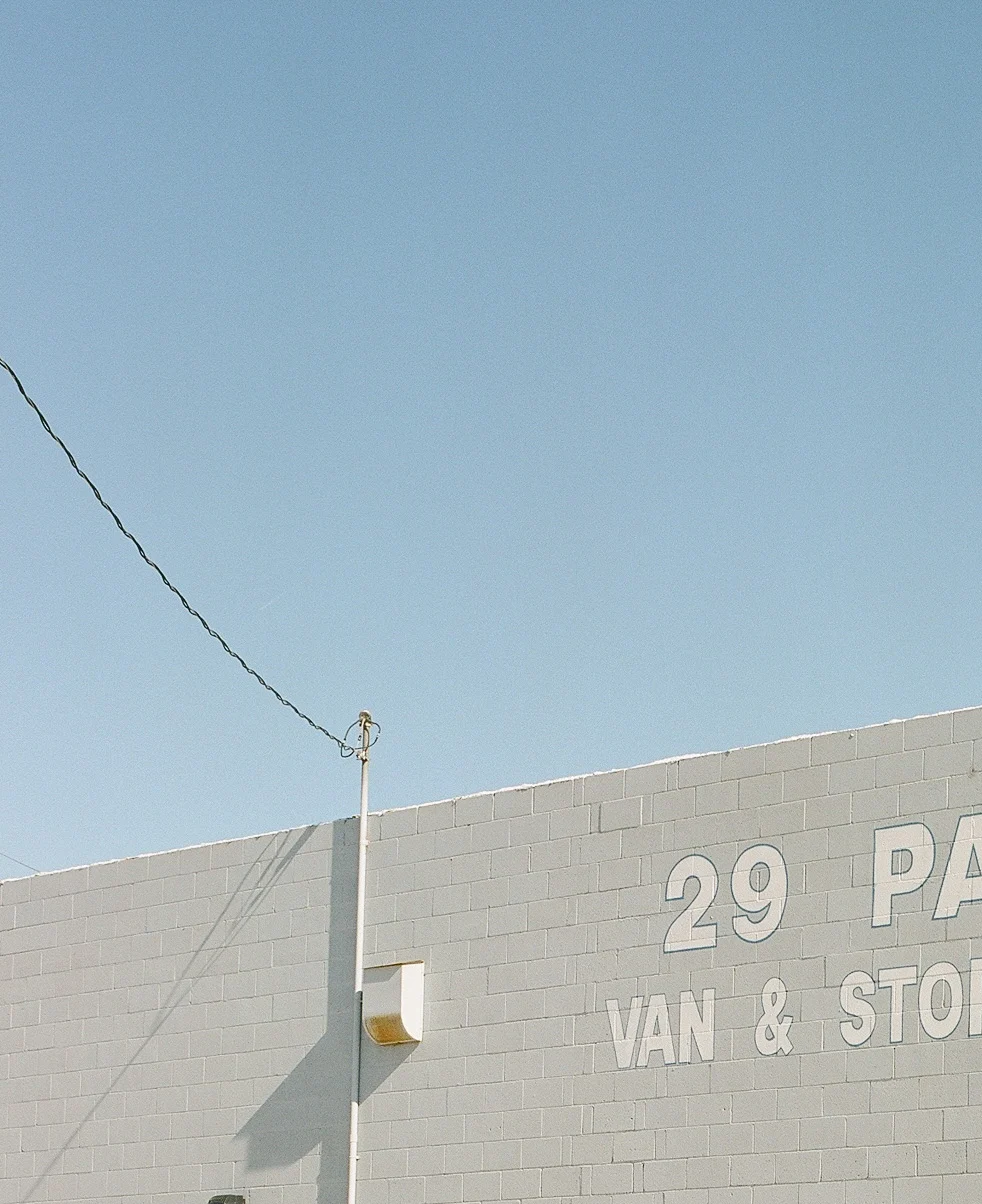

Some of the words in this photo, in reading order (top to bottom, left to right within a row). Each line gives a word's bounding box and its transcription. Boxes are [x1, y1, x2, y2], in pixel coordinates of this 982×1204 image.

[663, 843, 788, 953] 29
[605, 988, 716, 1069] VAN
[754, 977, 794, 1056] &
